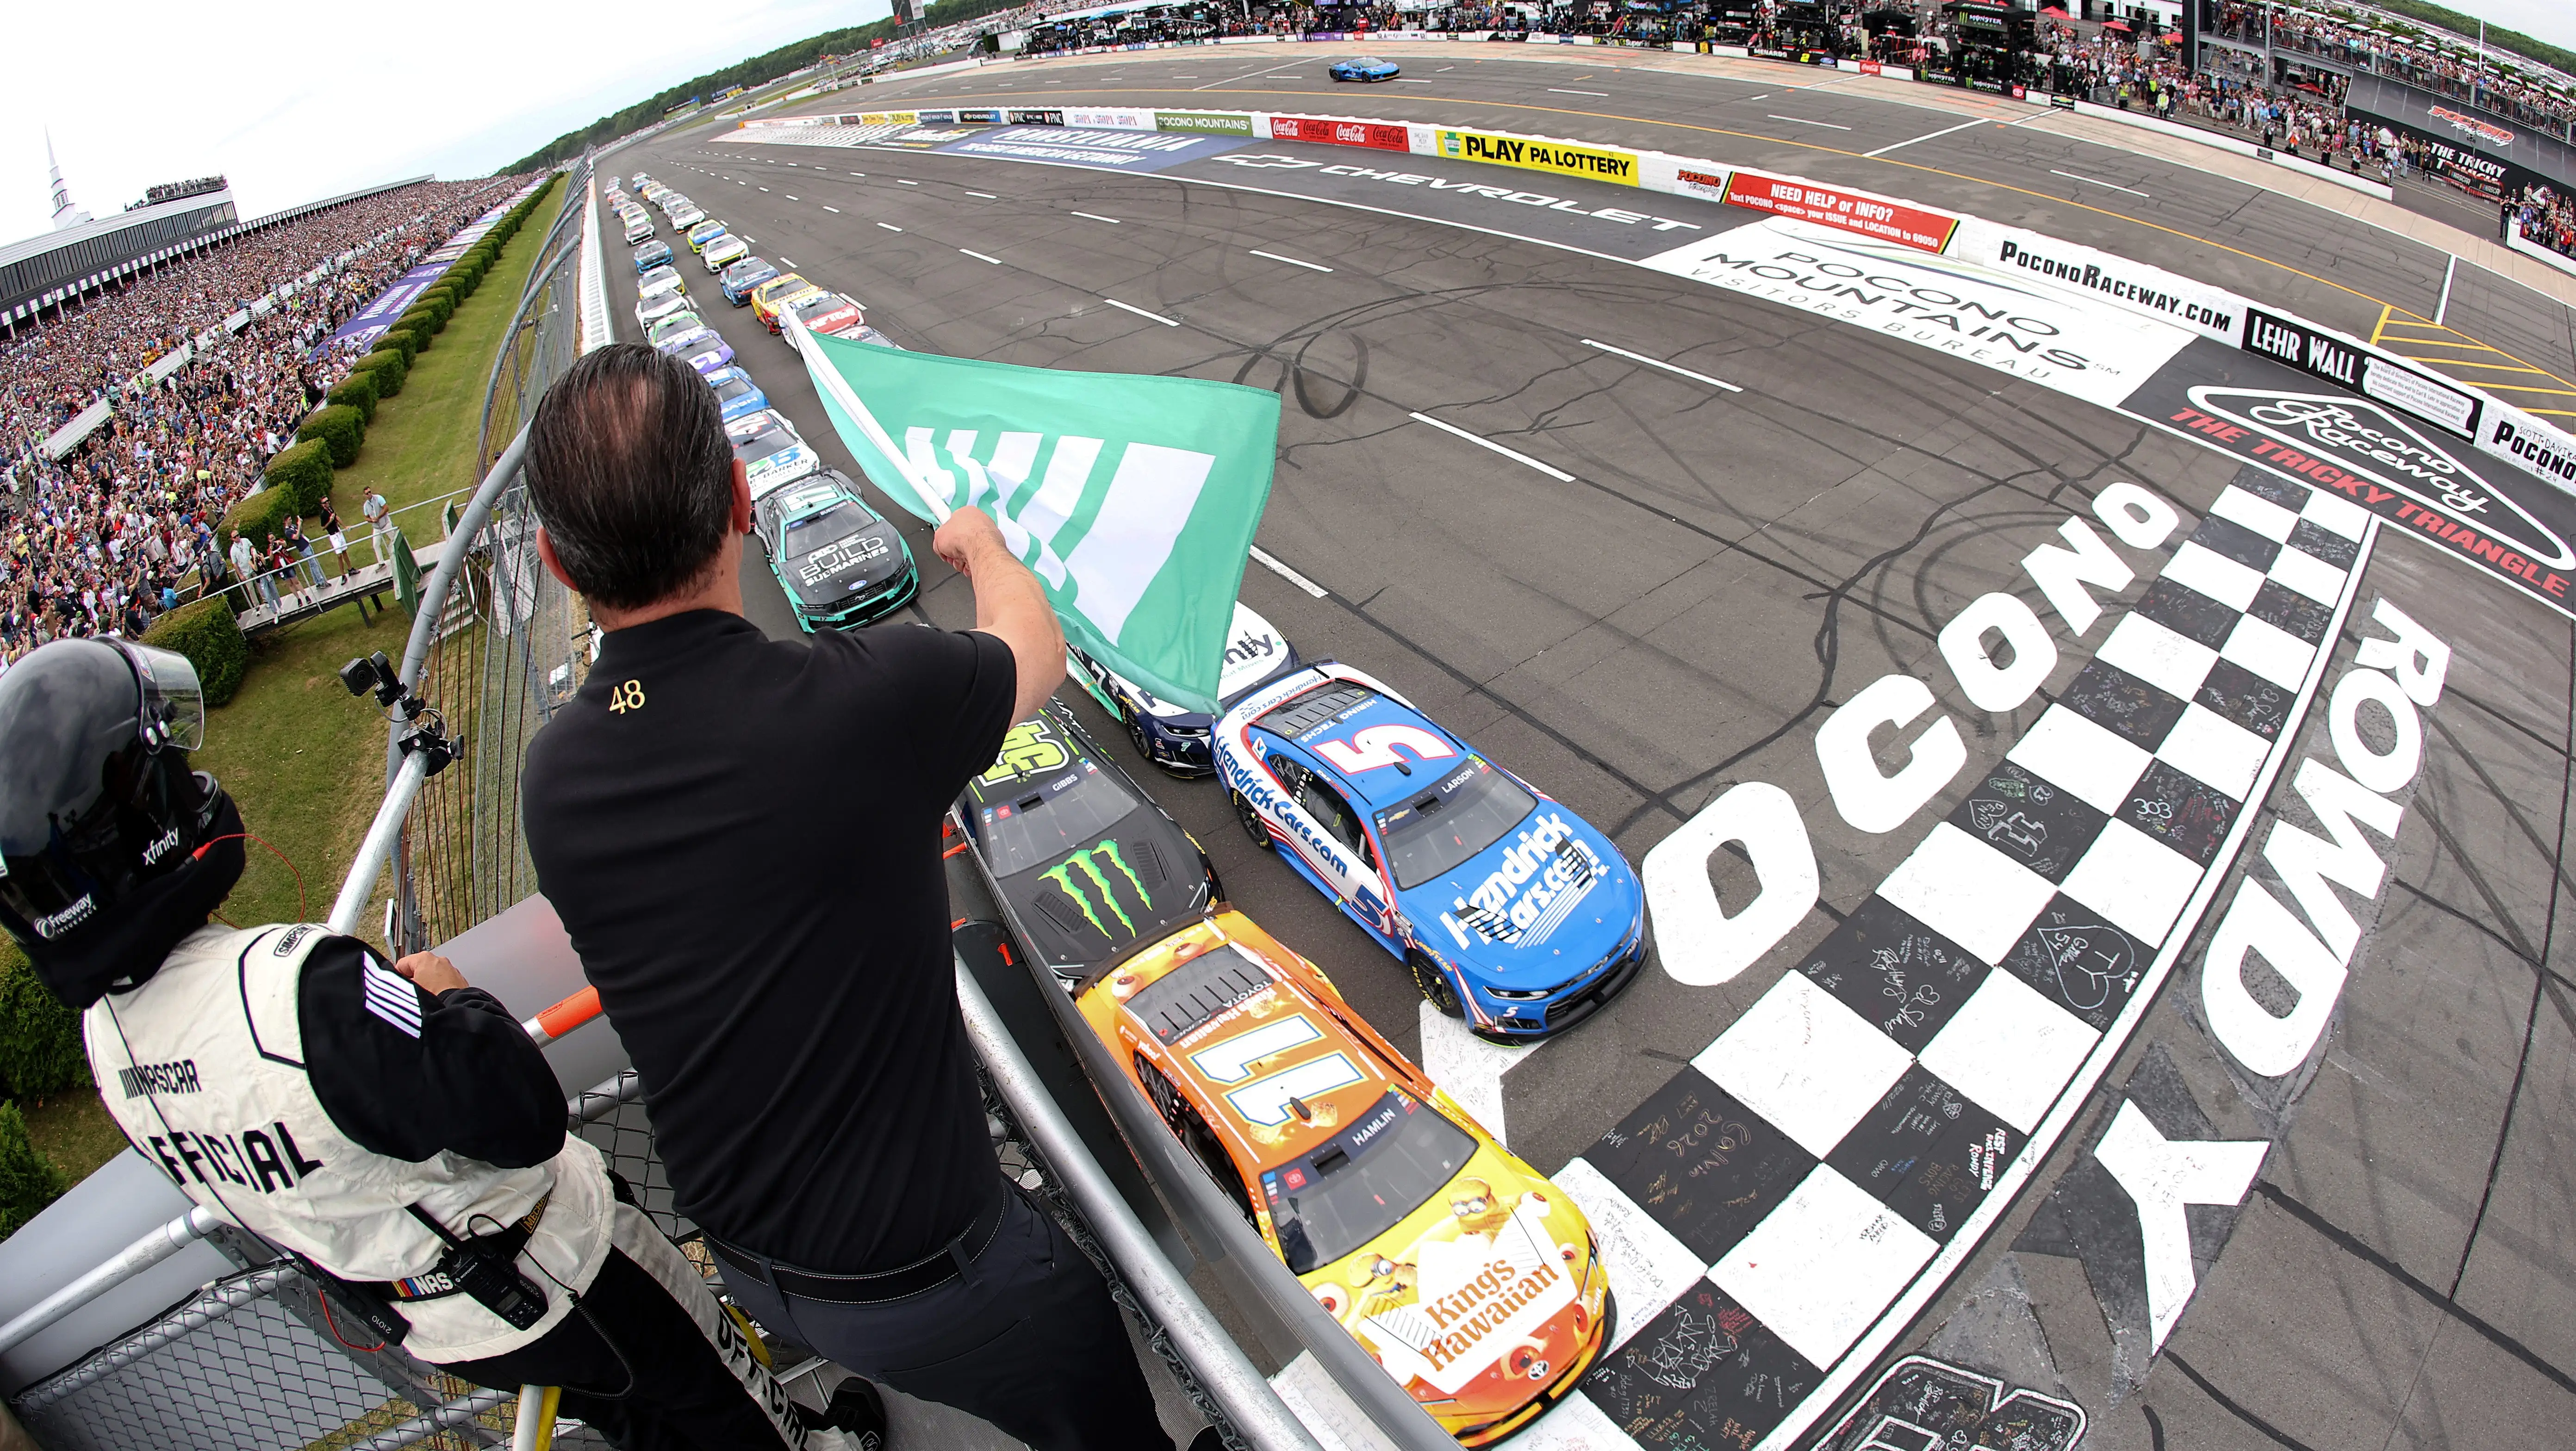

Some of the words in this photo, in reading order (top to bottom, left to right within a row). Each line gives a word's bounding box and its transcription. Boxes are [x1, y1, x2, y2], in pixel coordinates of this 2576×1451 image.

[1969, 15, 2001, 25] MONSTER
[1754, 48, 1787, 57] MENARDS
[1929, 73, 1955, 82] MONSTER
[1973, 81, 2002, 91] MONSTER
[1014, 112, 1025, 123] PNC
[1050, 113, 1062, 124] PNC
[1158, 117, 1193, 127] POCONO
[1195, 118, 1247, 130] MOUNTAINS
[1273, 118, 1299, 136] Coca-Cola
[1303, 121, 1329, 135] Coca-Cola
[1336, 124, 1366, 143] Coca-Cola
[1373, 126, 1403, 144] Coca-Cola
[2428, 105, 2514, 142] POCONO
[1465, 136, 1525, 162] PLAY
[1530, 147, 1551, 164] PA
[1556, 150, 1630, 176] LOTTERY
[2430, 142, 2455, 161] THE
[2459, 152, 2507, 177] TRICKY
[1677, 169, 1720, 187] POCONO
[1319, 165, 1702, 231] CHEVROLET
[1771, 184, 1802, 202] NEED
[1805, 190, 1836, 209] HELP
[1839, 200, 1853, 213] or
[1855, 201, 1894, 222] INFO?
[1730, 192, 1744, 202] Text
[1745, 195, 1773, 208] POCONO
[1774, 203, 1805, 215] <space>
[1807, 210, 1823, 220] your
[1825, 211, 1847, 224] ISSUE
[1848, 217, 1863, 228] and
[1864, 221, 1901, 238] LOCATION
[1903, 230, 1911, 240] to
[1912, 233, 1938, 248] 69050
[1773, 251, 2060, 335] POCONO
[1691, 268, 1861, 319] VISITORS
[1882, 322, 2051, 378] BUREAU
[1701, 253, 2091, 370] MOUNTAINS
[2251, 316, 2301, 362] LEHR
[2308, 336, 2355, 384] WALL
[2249, 399, 2456, 475] Pocono
[2492, 420, 2576, 485] POCONO
[2305, 418, 2489, 515] Raceway
[2170, 408, 2251, 443] THE
[2252, 438, 2396, 508] TRICKY
[2395, 501, 2570, 598] TRIANGLE
[799, 537, 884, 580] BUILD
[805, 546, 889, 587] SUBMARINES
[1238, 658, 1264, 672] Moves
[609, 679, 646, 714] 48
[1339, 699, 1378, 720] HIRING
[1181, 742, 1191, 751] 7
[1300, 719, 1336, 743] TECHS
[1311, 724, 1458, 775] 5
[1052, 773, 1078, 792] GIBBS
[1441, 768, 1474, 794] LARSON
[142, 826, 180, 866] xfinity
[1438, 812, 1576, 951] Hendrick
[48, 891, 94, 927] Freeway
[1350, 881, 1393, 937] 5
[1414, 937, 1453, 972] GOODYEAR
[1222, 980, 1272, 1008] TOYOTA
[2093, 597, 2452, 1358] ROWDY
[1503, 1006, 1519, 1017] 5
[138, 1058, 201, 1098] NASCAR
[1187, 1012, 1369, 1126] 11
[1351, 1108, 1396, 1147] HAMLIN
[1994, 1127, 2008, 1155] REST
[143, 1121, 323, 1195] FFICIAL
[1968, 1143, 1984, 1178] ROWDY
[413, 1272, 454, 1295] NAS
[460, 1262, 478, 1279] MOTOROLA
[1425, 1259, 1516, 1331] King's
[372, 1315, 392, 1334] 21010
[1421, 1263, 1560, 1372] Hawaiian
